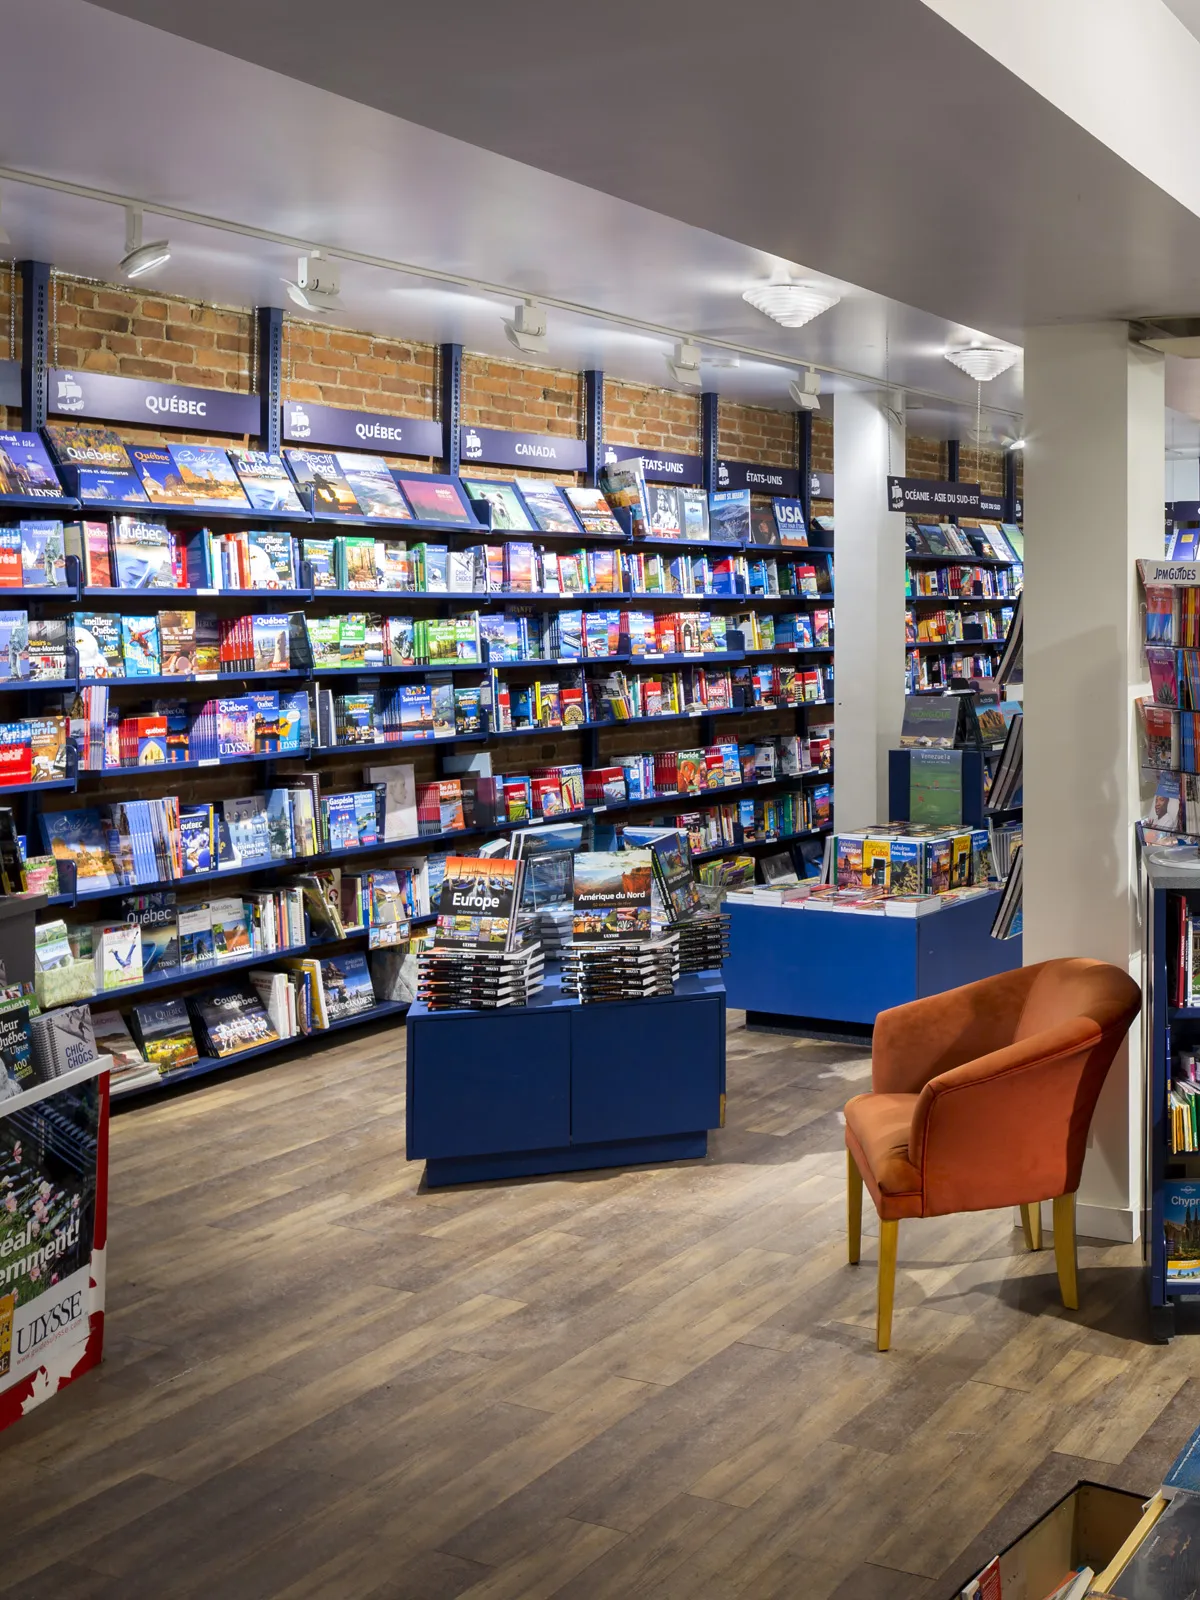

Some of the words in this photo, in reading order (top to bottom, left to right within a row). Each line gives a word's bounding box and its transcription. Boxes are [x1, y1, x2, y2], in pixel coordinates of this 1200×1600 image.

[146, 396, 206, 416] QUÉBEC
[356, 422, 402, 441] QUÉBEC
[67, 447, 120, 462] Québec
[134, 451, 169, 462] Québec
[290, 450, 334, 465] Objectif
[515, 443, 556, 459] CANADA
[238, 461, 280, 474] Québec
[307, 462, 335, 475] Nord
[640, 455, 683, 473] ÉTATS-UNIS
[746, 472, 783, 486] ÉTATS-UNIS
[904, 489, 930, 500] OCÉANIE
[934, 493, 945, 502] ASIE
[946, 494, 956, 503] DU
[956, 494, 979, 505] SUD-EST
[776, 505, 803, 523] USA
[119, 523, 162, 542] Québec
[84, 617, 112, 627] meilleur
[257, 617, 288, 626] Québec
[91, 626, 118, 636] Québec
[709, 687, 724, 695] SOLDE
[219, 704, 248, 713] Québec
[145, 727, 166, 735] québec
[219, 743, 252, 755] ULYSSE
[678, 751, 699, 760] Floride
[921, 752, 950, 760] Venezuela
[562, 767, 582, 775] Toronto
[180, 820, 202, 829] QUÉBEC
[871, 848, 888, 857] Cuba
[452, 892, 499, 908] Europe
[578, 892, 614, 901] Amérique
[615, 892, 625, 900] du
[626, 890, 645, 900] Nord
[126, 908, 172, 925] Québec
[213, 992, 243, 1005] Coupe
[65, 1042, 85, 1058] CHIC-
[67, 1049, 94, 1069] CHOCS
[16, 1290, 83, 1356] ULYSSE
[16, 1318, 82, 1367] www.guidesulysse.com
